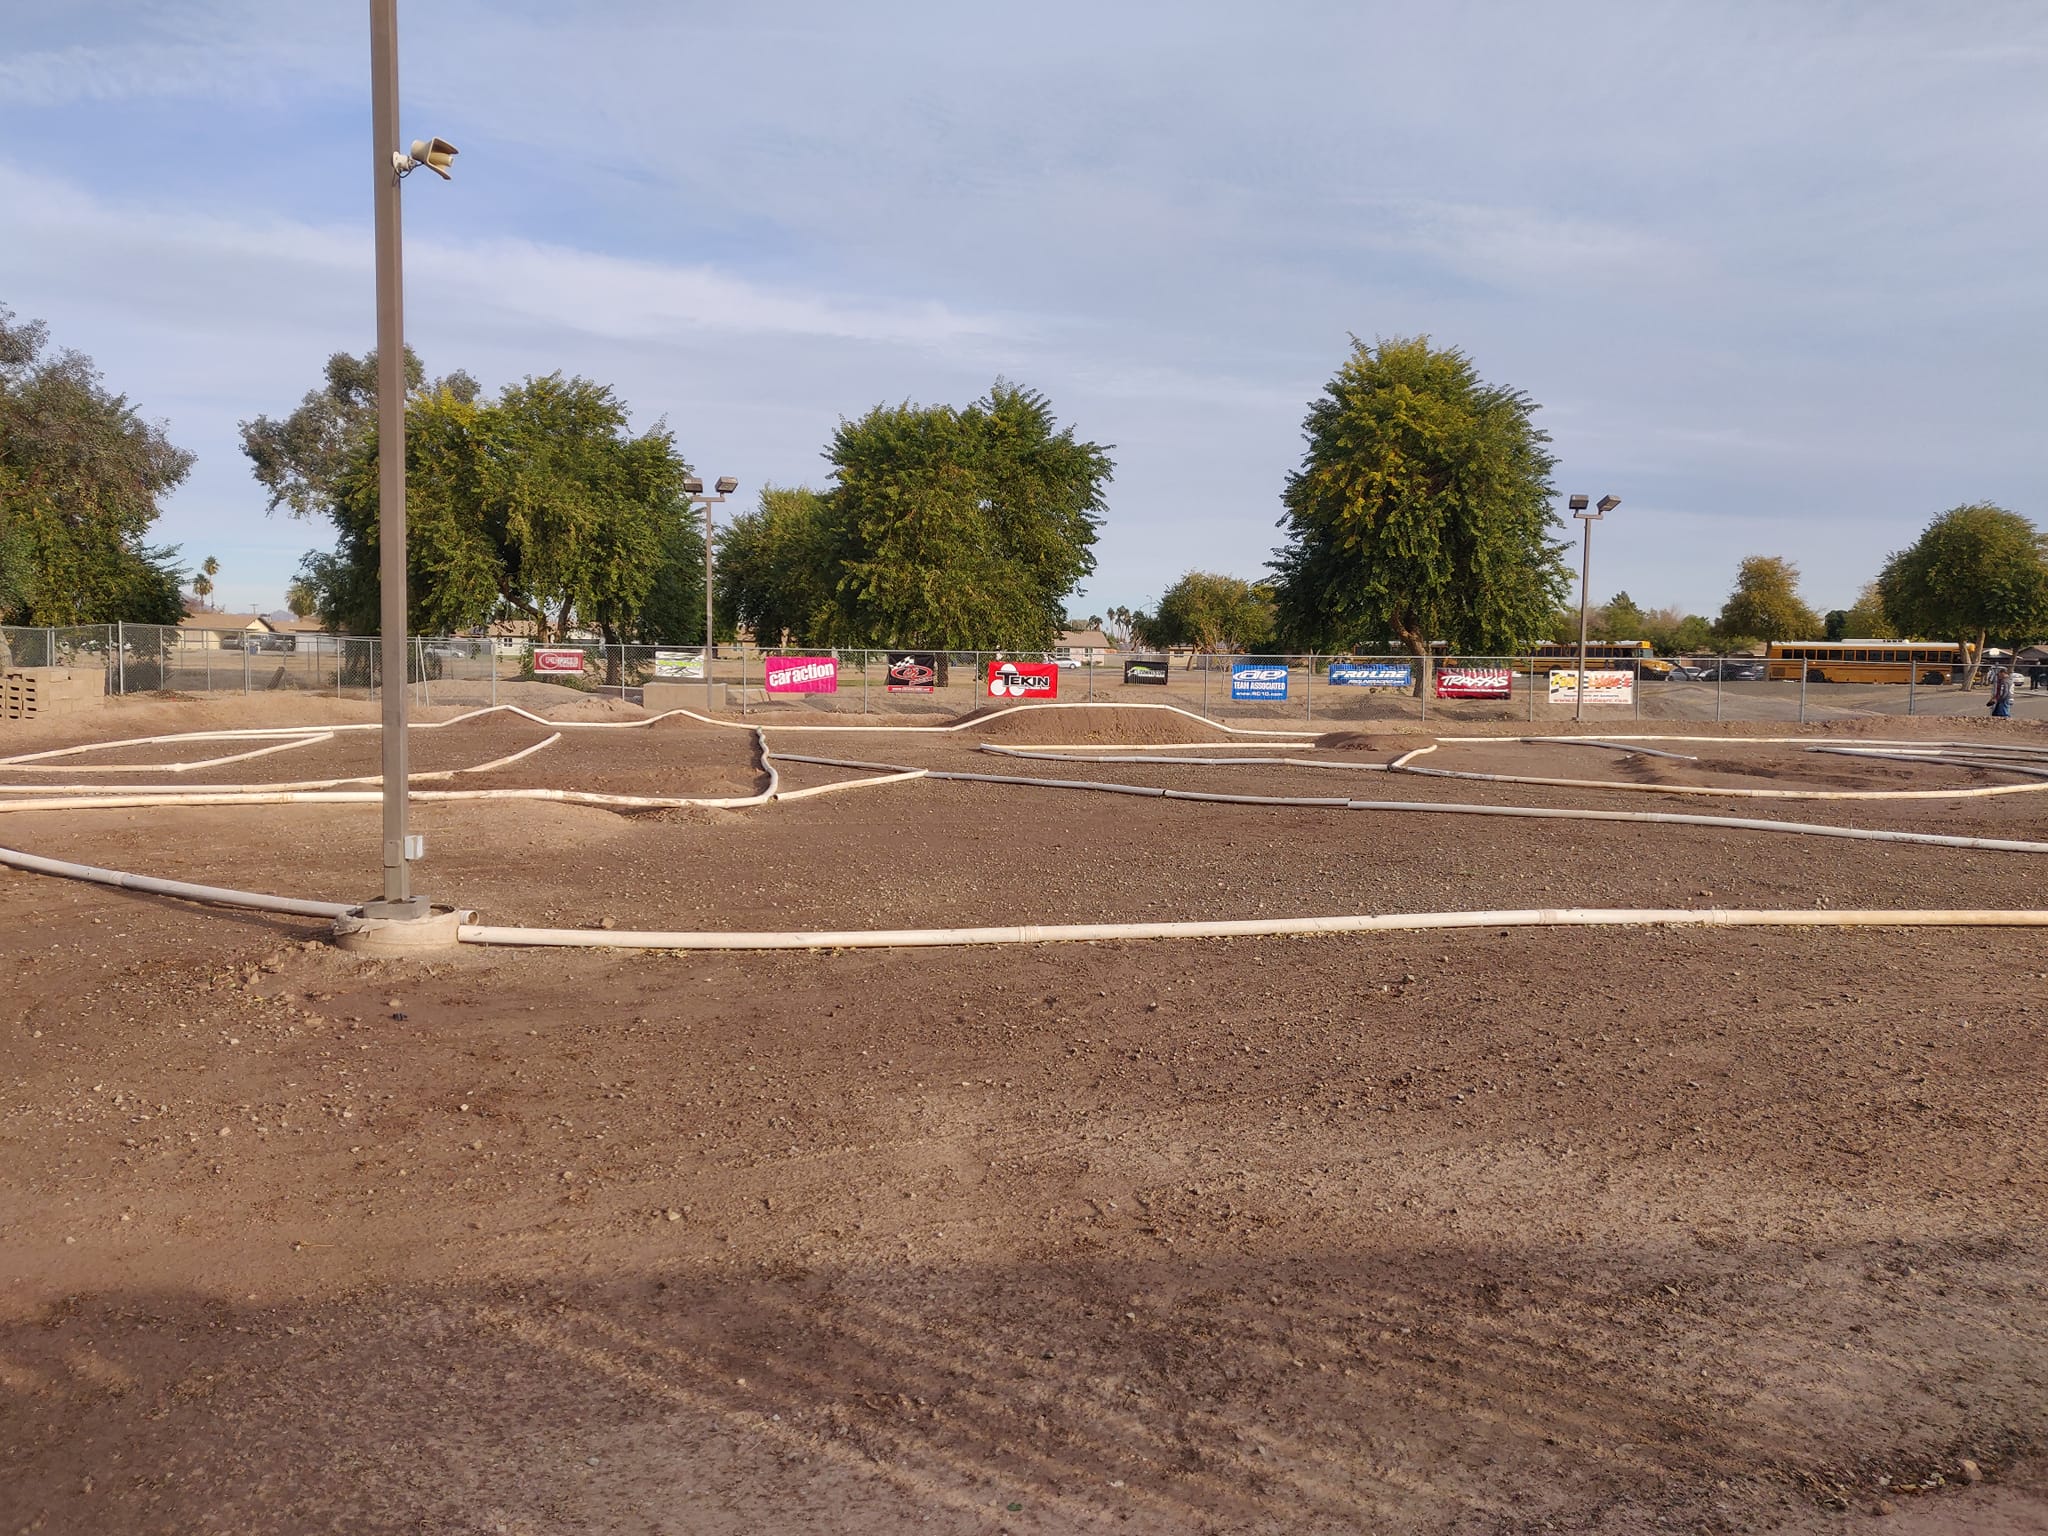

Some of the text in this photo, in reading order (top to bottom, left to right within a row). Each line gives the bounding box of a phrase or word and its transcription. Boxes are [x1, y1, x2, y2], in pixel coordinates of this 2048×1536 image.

[769, 670, 791, 686] car
[792, 663, 834, 682] action
[996, 671, 1049, 688] TEKIN
[1441, 674, 1509, 688] TRAXXAS
[1250, 682, 1285, 690] ASSOCIATED
